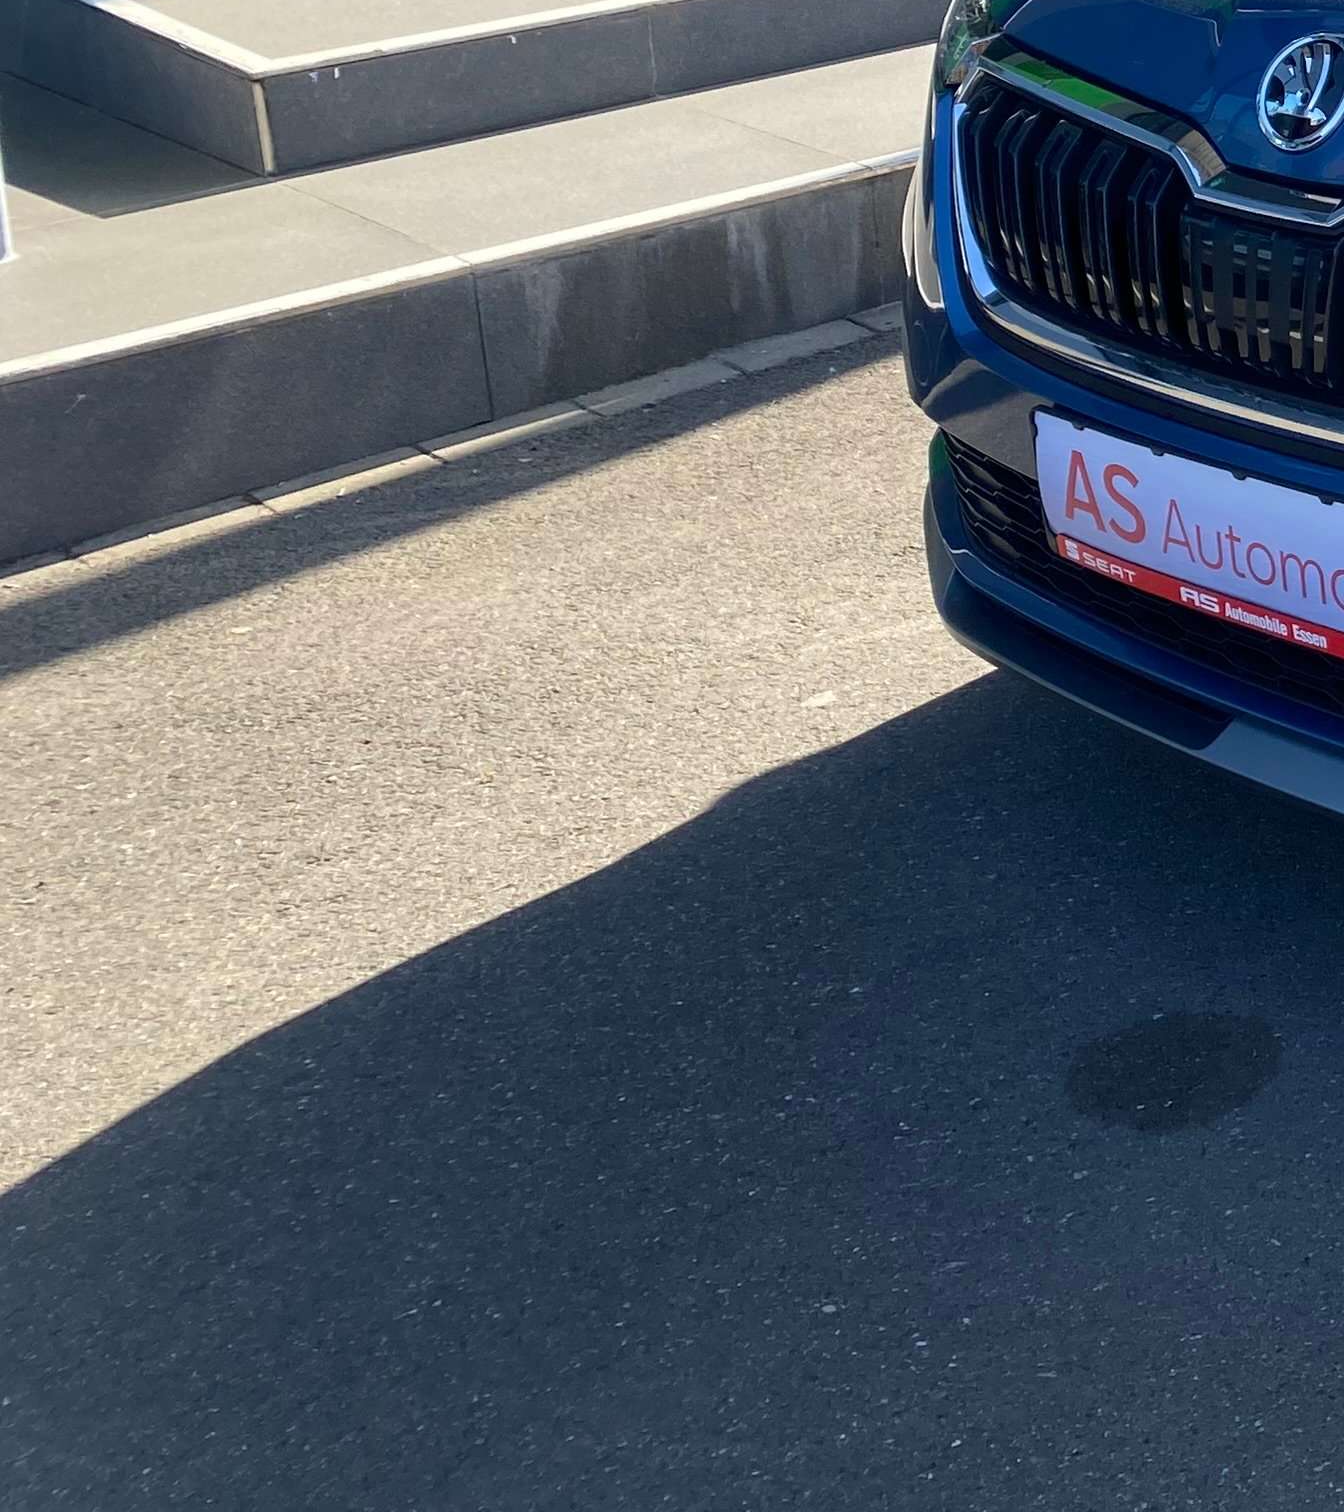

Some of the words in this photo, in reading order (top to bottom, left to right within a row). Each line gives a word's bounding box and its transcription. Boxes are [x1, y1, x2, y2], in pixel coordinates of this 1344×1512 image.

[1064, 449, 1147, 544] AS
[1082, 551, 1137, 584] SEAT
[1224, 601, 1289, 638] Automobile
[1291, 623, 1329, 649] Essen
